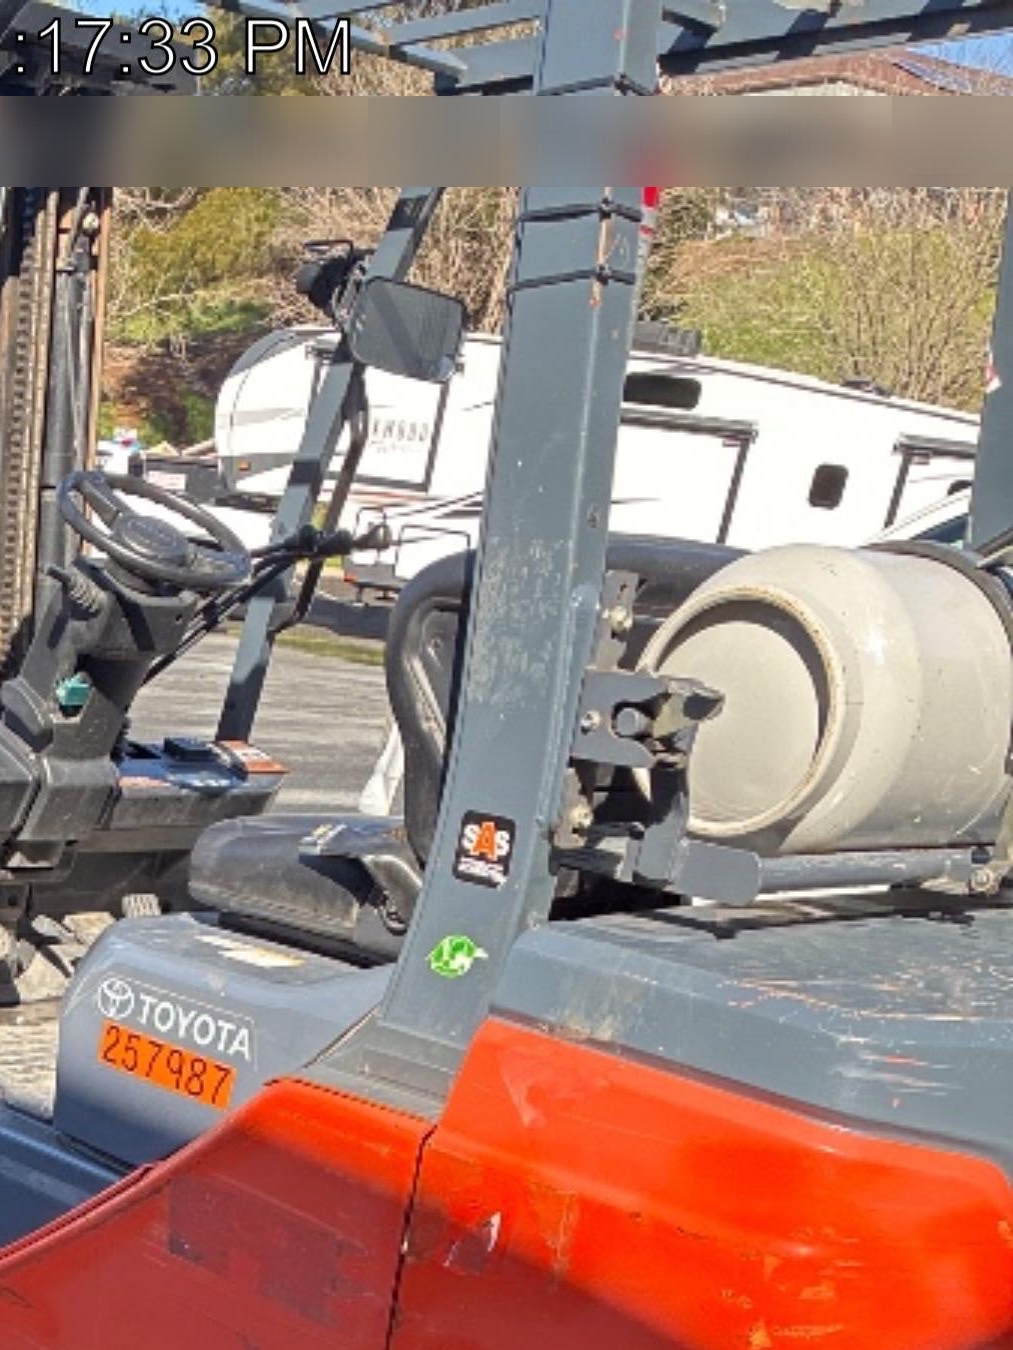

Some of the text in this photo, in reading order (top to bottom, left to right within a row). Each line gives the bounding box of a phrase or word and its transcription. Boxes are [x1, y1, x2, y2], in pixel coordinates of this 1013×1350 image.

[461, 820, 510, 861] SAS
[138, 992, 251, 1062] TOYOTA
[102, 1025, 232, 1105] 257987
